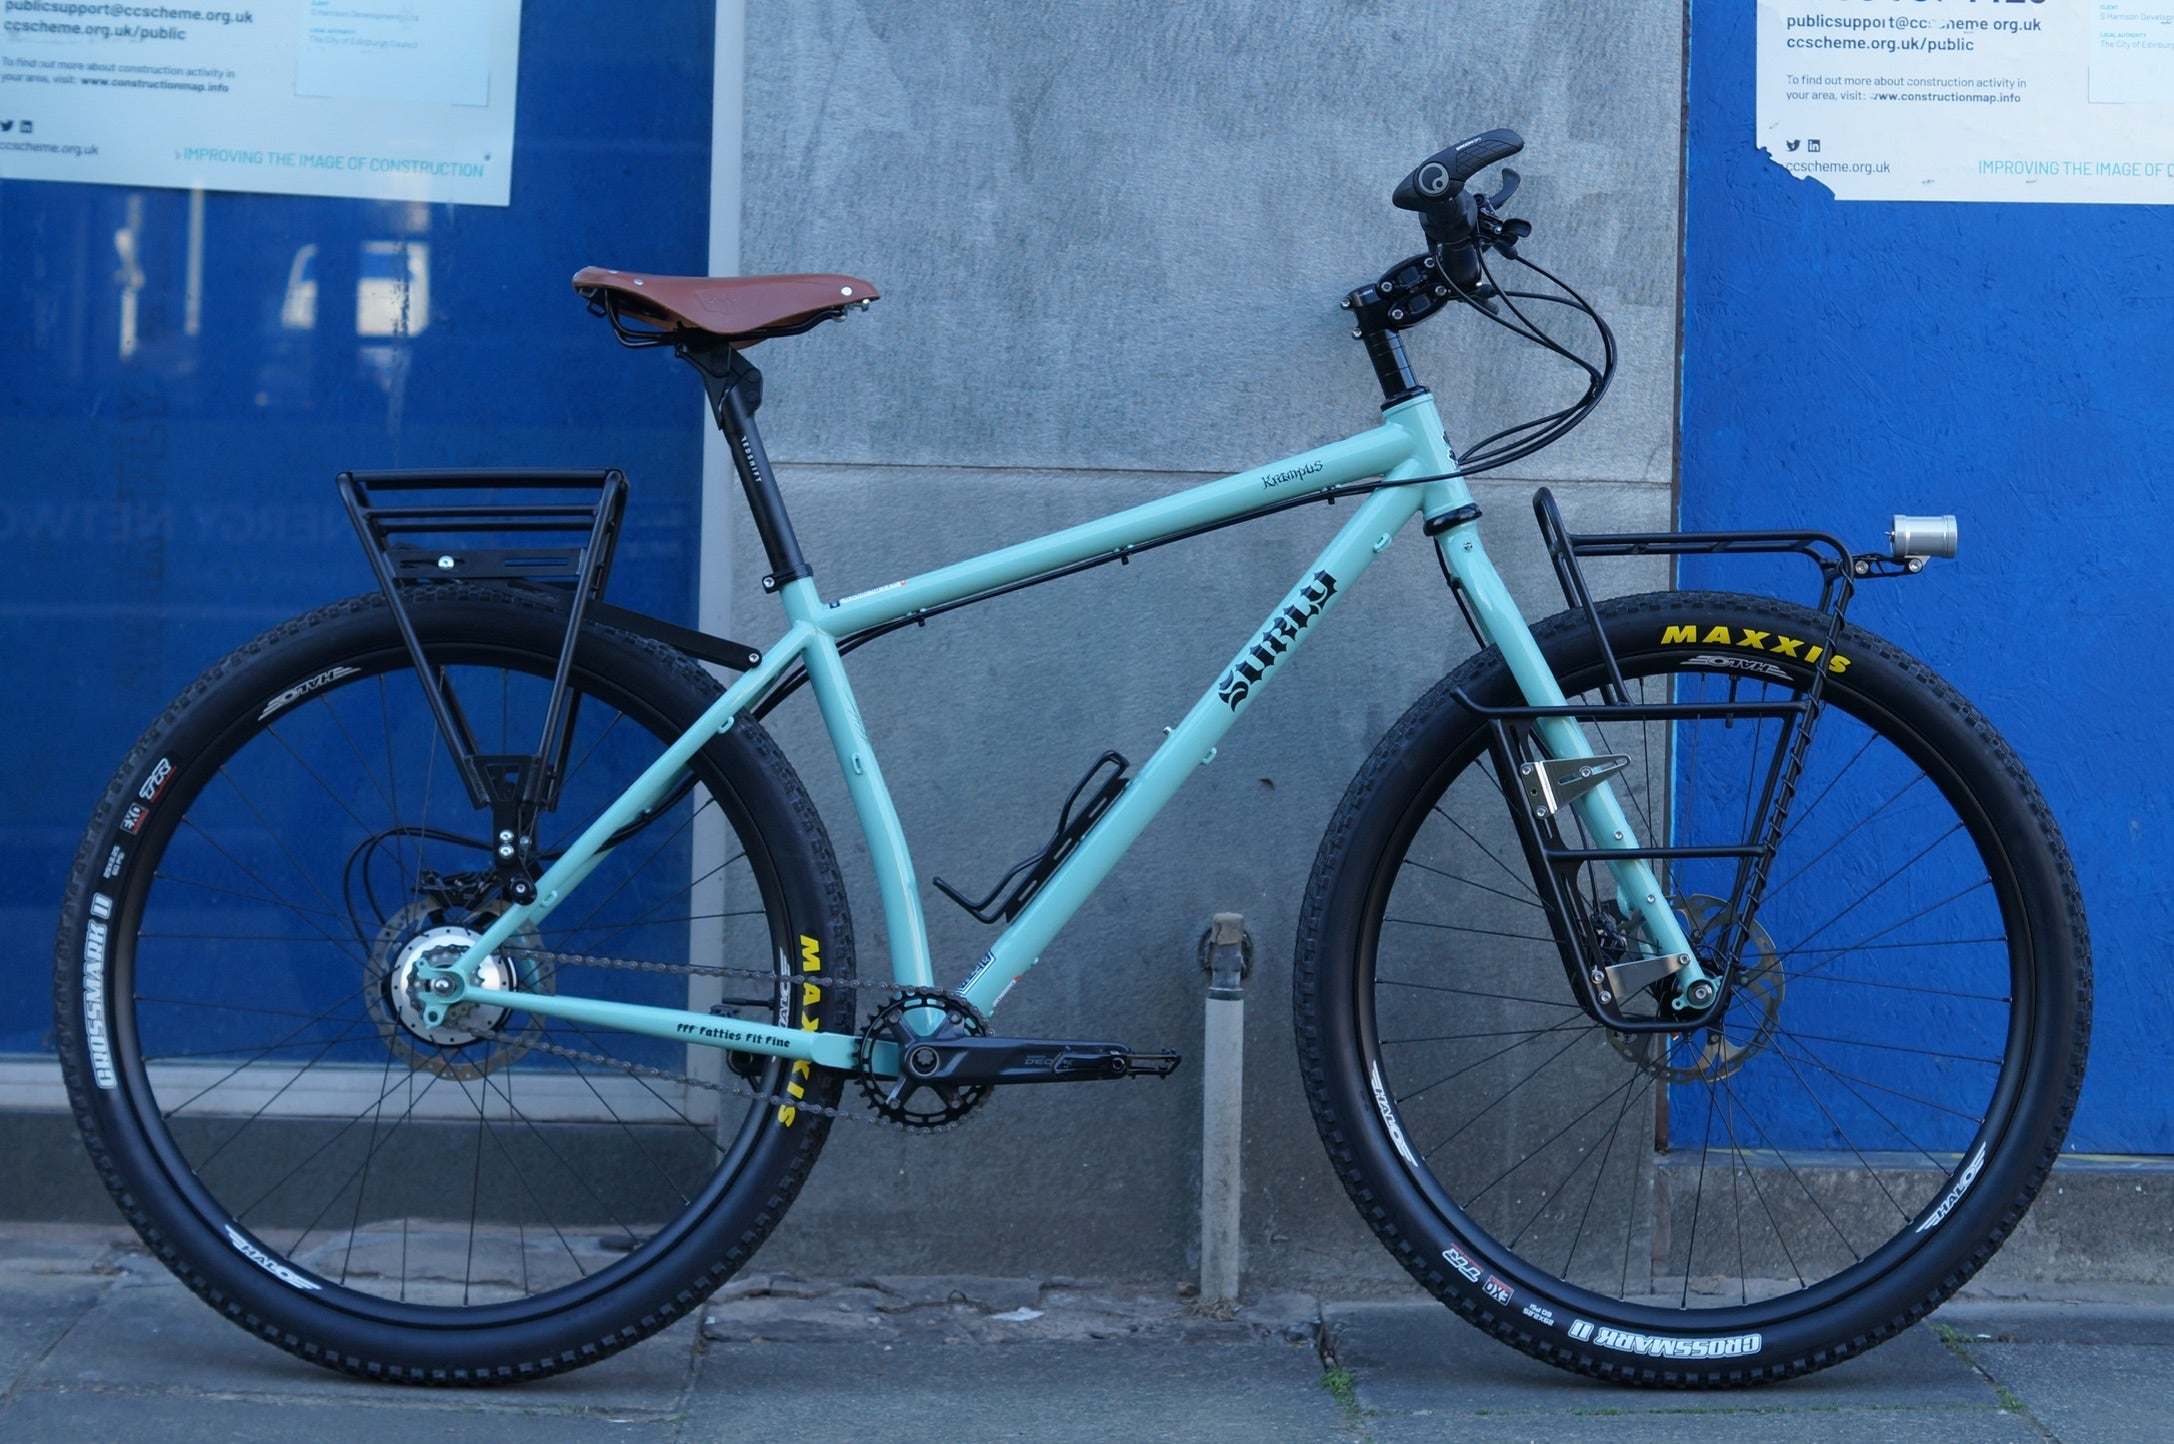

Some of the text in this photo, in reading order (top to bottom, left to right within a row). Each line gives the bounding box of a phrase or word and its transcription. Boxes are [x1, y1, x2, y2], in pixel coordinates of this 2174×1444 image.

[5, 0, 253, 24] publicsupport@ccscheme.org.uk
[3, 18, 186, 40] ccscheme.org.uk/public
[1786, 35, 1975, 53] ccscheme.org.uk/public
[1787, 74, 2027, 90] To find out more about construction activity in
[1786, 91, 1810, 101] your
[183, 147, 484, 178] IMPROVING THE IMAGE OF CONSTRUCTION
[1786, 160, 1891, 176] ccscheme.org.uk
[1978, 160, 2059, 176] IMPROVING
[2062, 160, 2092, 176] THE
[2095, 161, 2141, 177] IMAGE
[2145, 161, 2164, 177] OF
[1260, 460, 1324, 489] Krampus
[1660, 624, 1851, 673] MAXXIS
[84, 919, 117, 1088] CROSSMARK
[1484, 1281, 1509, 1303] EXO
[1593, 1327, 1763, 1359] CROSSMARK
